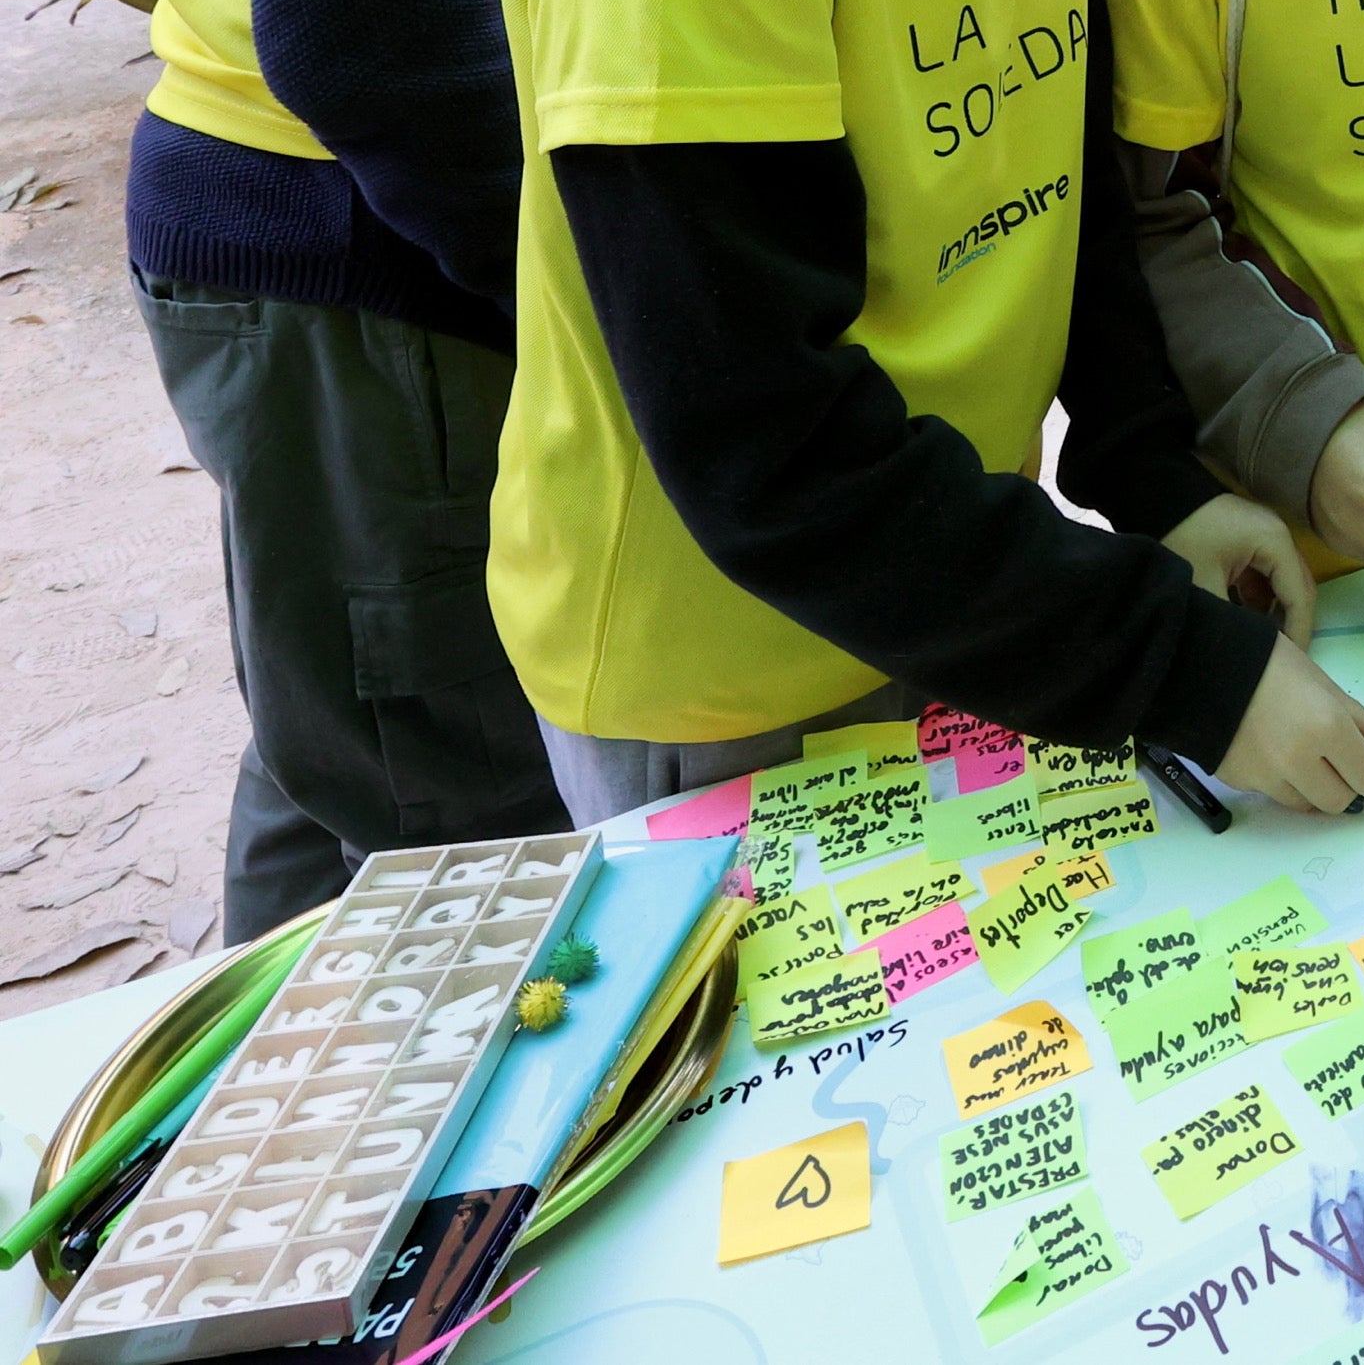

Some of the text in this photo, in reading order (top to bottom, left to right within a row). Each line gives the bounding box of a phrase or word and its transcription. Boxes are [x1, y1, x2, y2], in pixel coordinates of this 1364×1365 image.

[909, 5, 986, 72] LA
[937, 174, 1070, 273] innspire
[759, 784, 798, 804] libre
[977, 798, 1030, 825] libros
[986, 819, 1041, 841] Tener
[734, 899, 807, 942] vacun
[796, 916, 835, 942] las
[858, 890, 957, 935] rioridad
[978, 881, 1069, 949] Deportes
[1041, 1017, 1064, 1036] de
[1193, 996, 1243, 1039] para
[666, 1019, 910, 1126] Salud y depo
[1163, 1033, 1248, 1081] cciones
[1320, 1086, 1354, 1118] del
[1192, 1101, 1263, 1154] dinero
[1214, 1130, 1297, 1181] Donar
[1035, 1255, 1113, 1307] Donar
